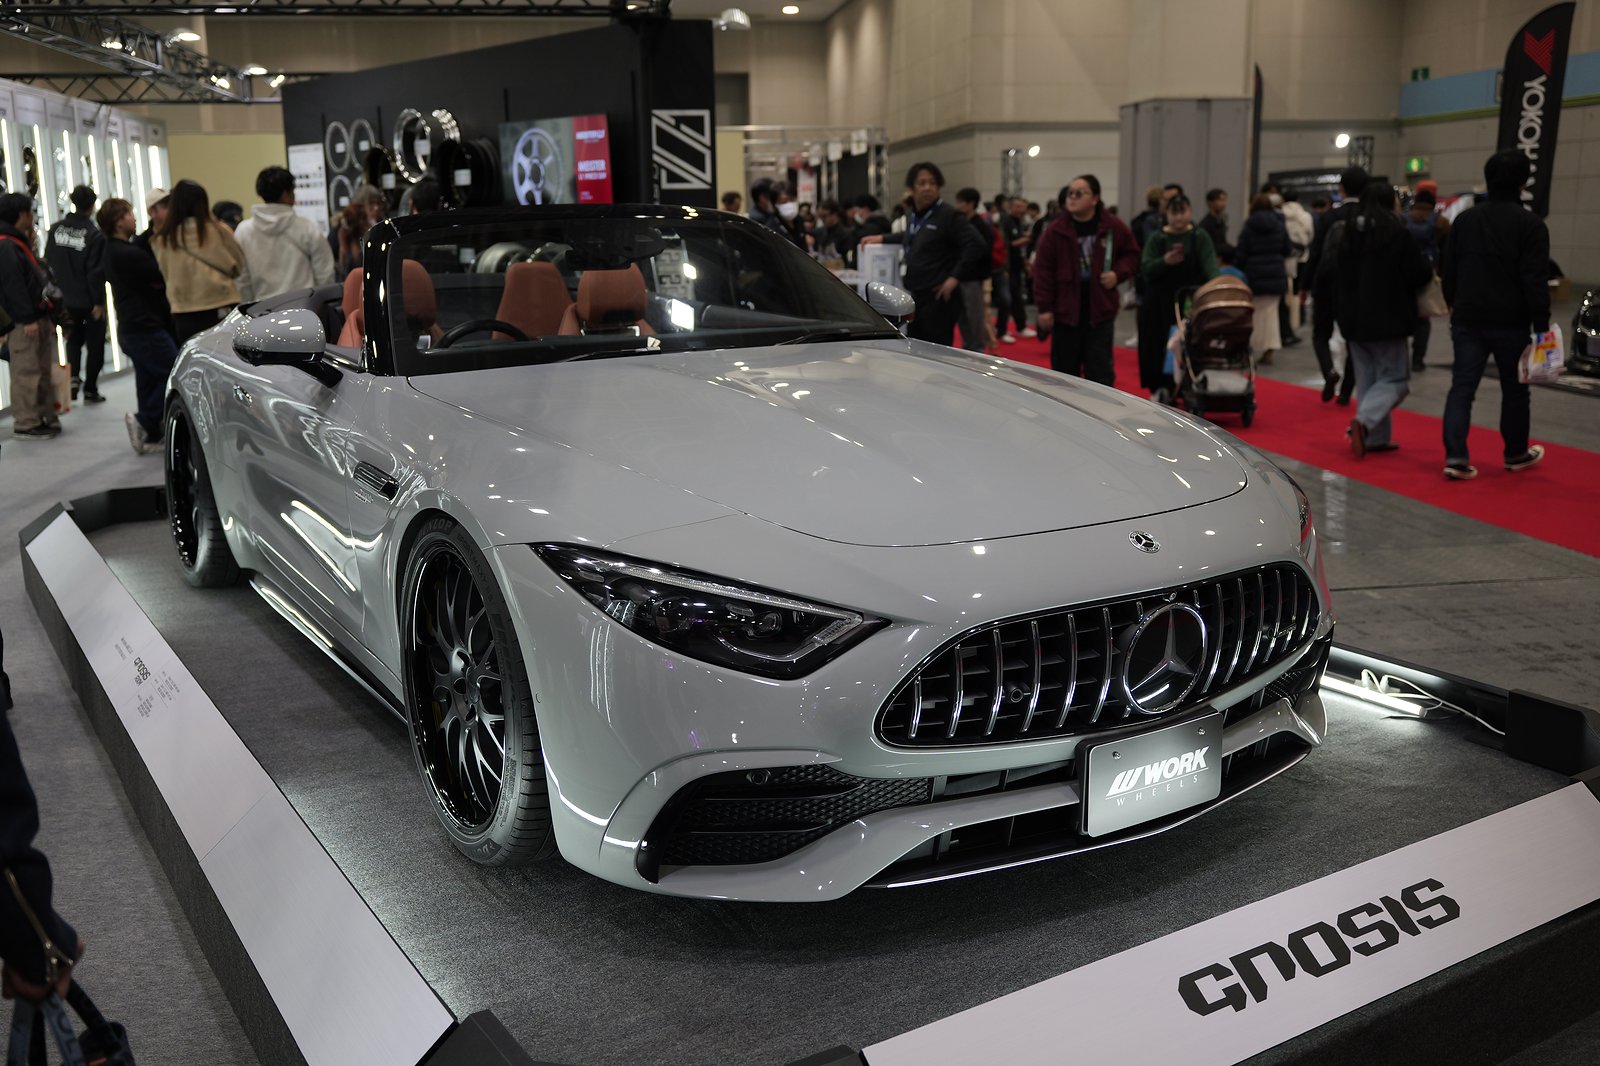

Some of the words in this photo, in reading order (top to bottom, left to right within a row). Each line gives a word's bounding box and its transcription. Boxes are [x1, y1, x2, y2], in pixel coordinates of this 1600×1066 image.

[1516, 74, 1548, 212] YOKOH
[1143, 746, 1209, 785] WORK
[1115, 774, 1198, 807] WHEELS
